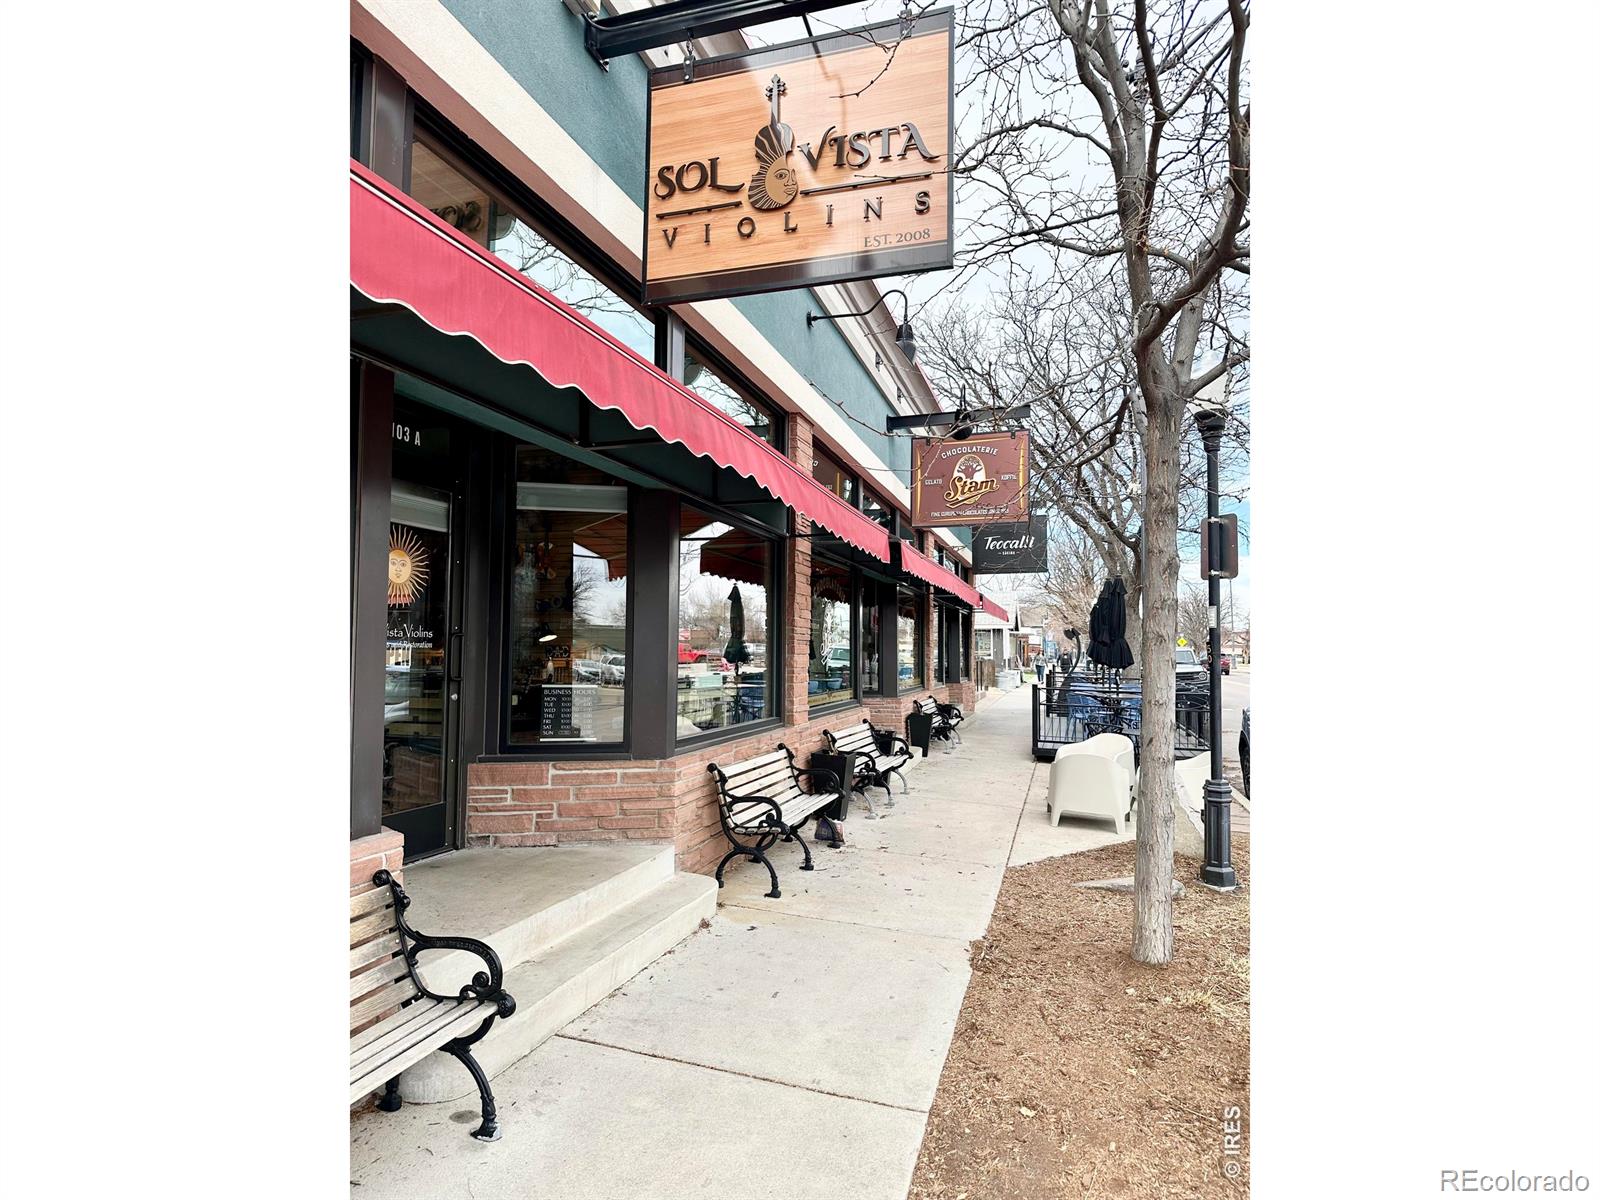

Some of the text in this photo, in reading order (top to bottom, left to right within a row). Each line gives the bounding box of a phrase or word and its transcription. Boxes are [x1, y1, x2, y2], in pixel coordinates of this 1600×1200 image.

[654, 122, 941, 200] SOL VISTA
[662, 190, 931, 250] VIOLINS
[863, 228, 931, 248] EST. 2008
[414, 431, 421, 446] A
[941, 446, 999, 459] CHOCOLATERIE
[944, 476, 1000, 501] Stam
[387, 623, 433, 638] ista Violins
